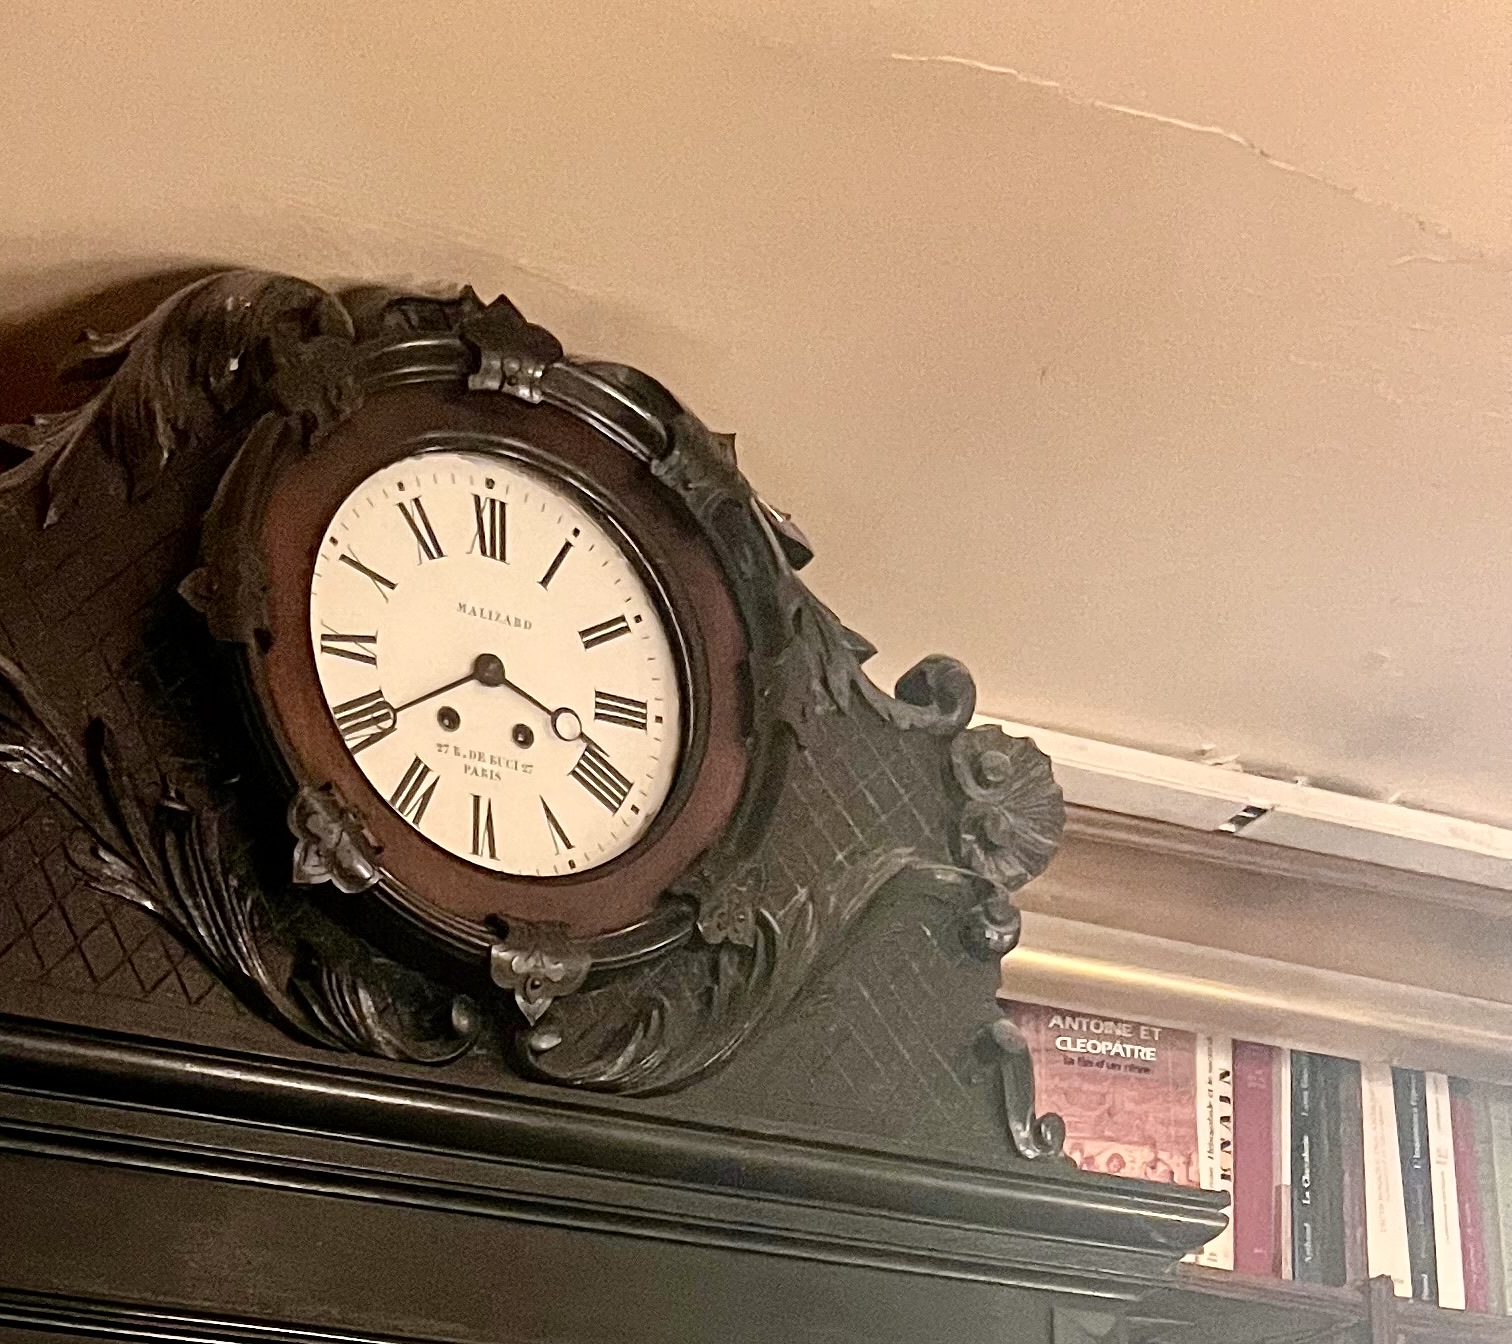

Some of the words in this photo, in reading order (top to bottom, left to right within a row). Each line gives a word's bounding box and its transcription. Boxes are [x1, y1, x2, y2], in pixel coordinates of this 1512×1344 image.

[396, 495, 447, 566] XI
[467, 493, 510, 565] XII
[338, 544, 399, 604] X
[537, 537, 575, 591] I
[456, 602, 532, 630] MALIZARD
[578, 614, 632, 651] II
[320, 619, 378, 669] IX
[594, 689, 648, 731] III
[436, 742, 450, 755] 27
[521, 763, 534, 775] 27
[464, 763, 502, 782] PARIS
[389, 753, 441, 828] VII
[470, 793, 500, 862] VI
[539, 794, 575, 856] V
[1048, 1015, 1134, 1038] ANTOINE
[1140, 1025, 1163, 1041] ET
